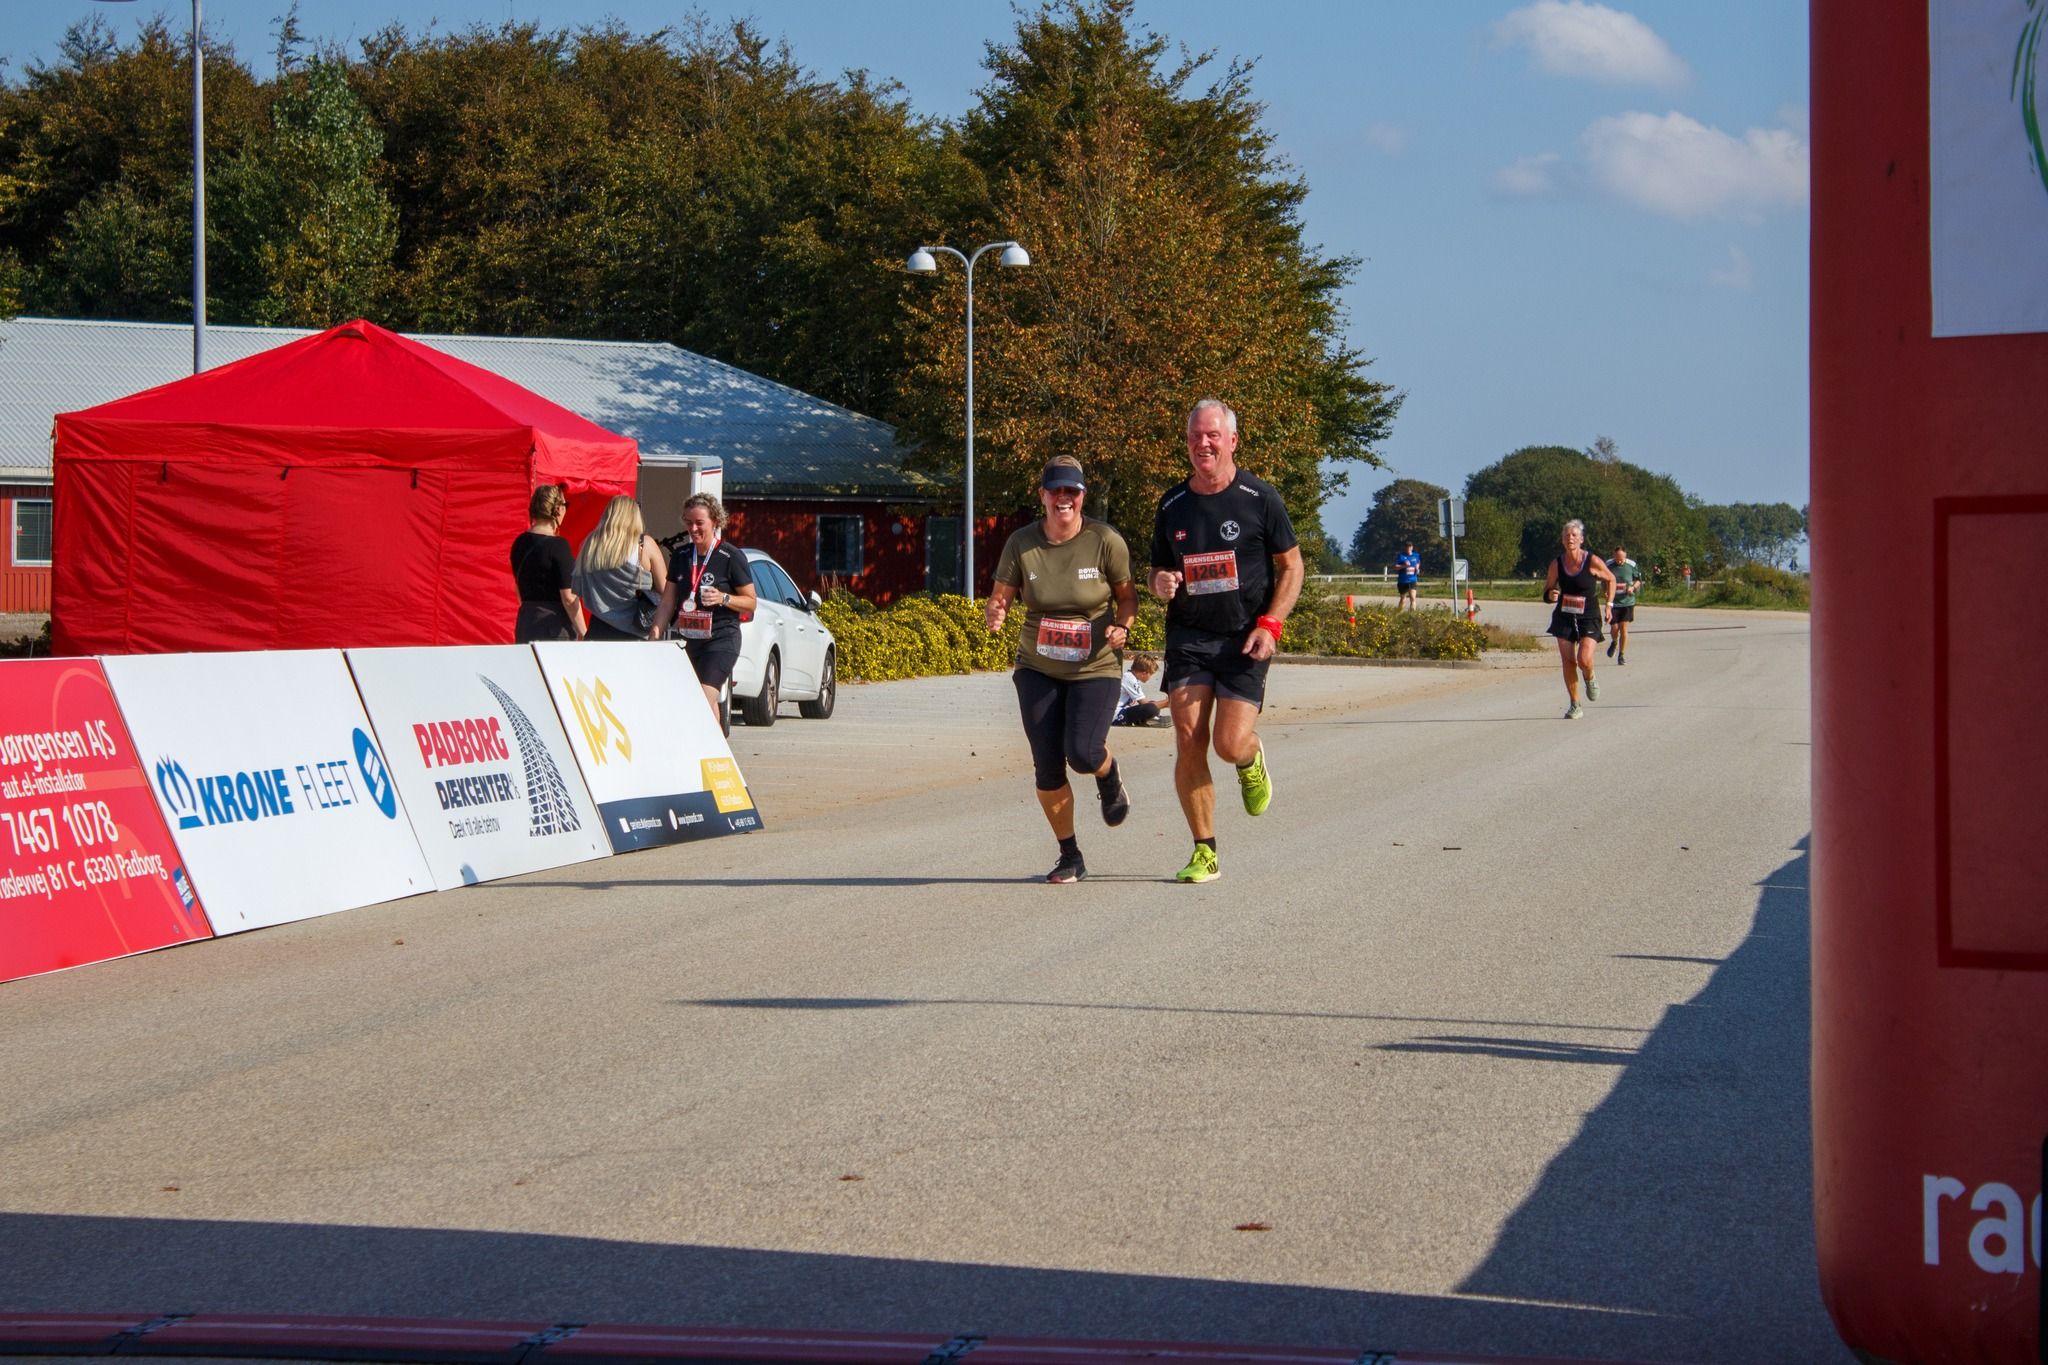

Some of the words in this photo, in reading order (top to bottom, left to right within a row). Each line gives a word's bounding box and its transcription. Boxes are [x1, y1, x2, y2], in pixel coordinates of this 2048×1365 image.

[1192, 563, 1228, 579] 1264
[1046, 630, 1083, 647] 1263
[85, 719, 117, 760] A/S
[562, 675, 633, 767] IPS
[412, 716, 510, 769] PADBORG
[1, 768, 87, 799] aut.el-installatør
[196, 768, 295, 826] KRONE
[295, 760, 359, 811] FLEET
[434, 773, 514, 811] DÆKCENTER
[1, 807, 59, 856] 7467
[62, 800, 119, 848] 1078
[47, 863, 69, 891] 81
[67, 860, 87, 891] C,
[84, 855, 118, 884] 6330
[114, 849, 168, 880] Padborg
